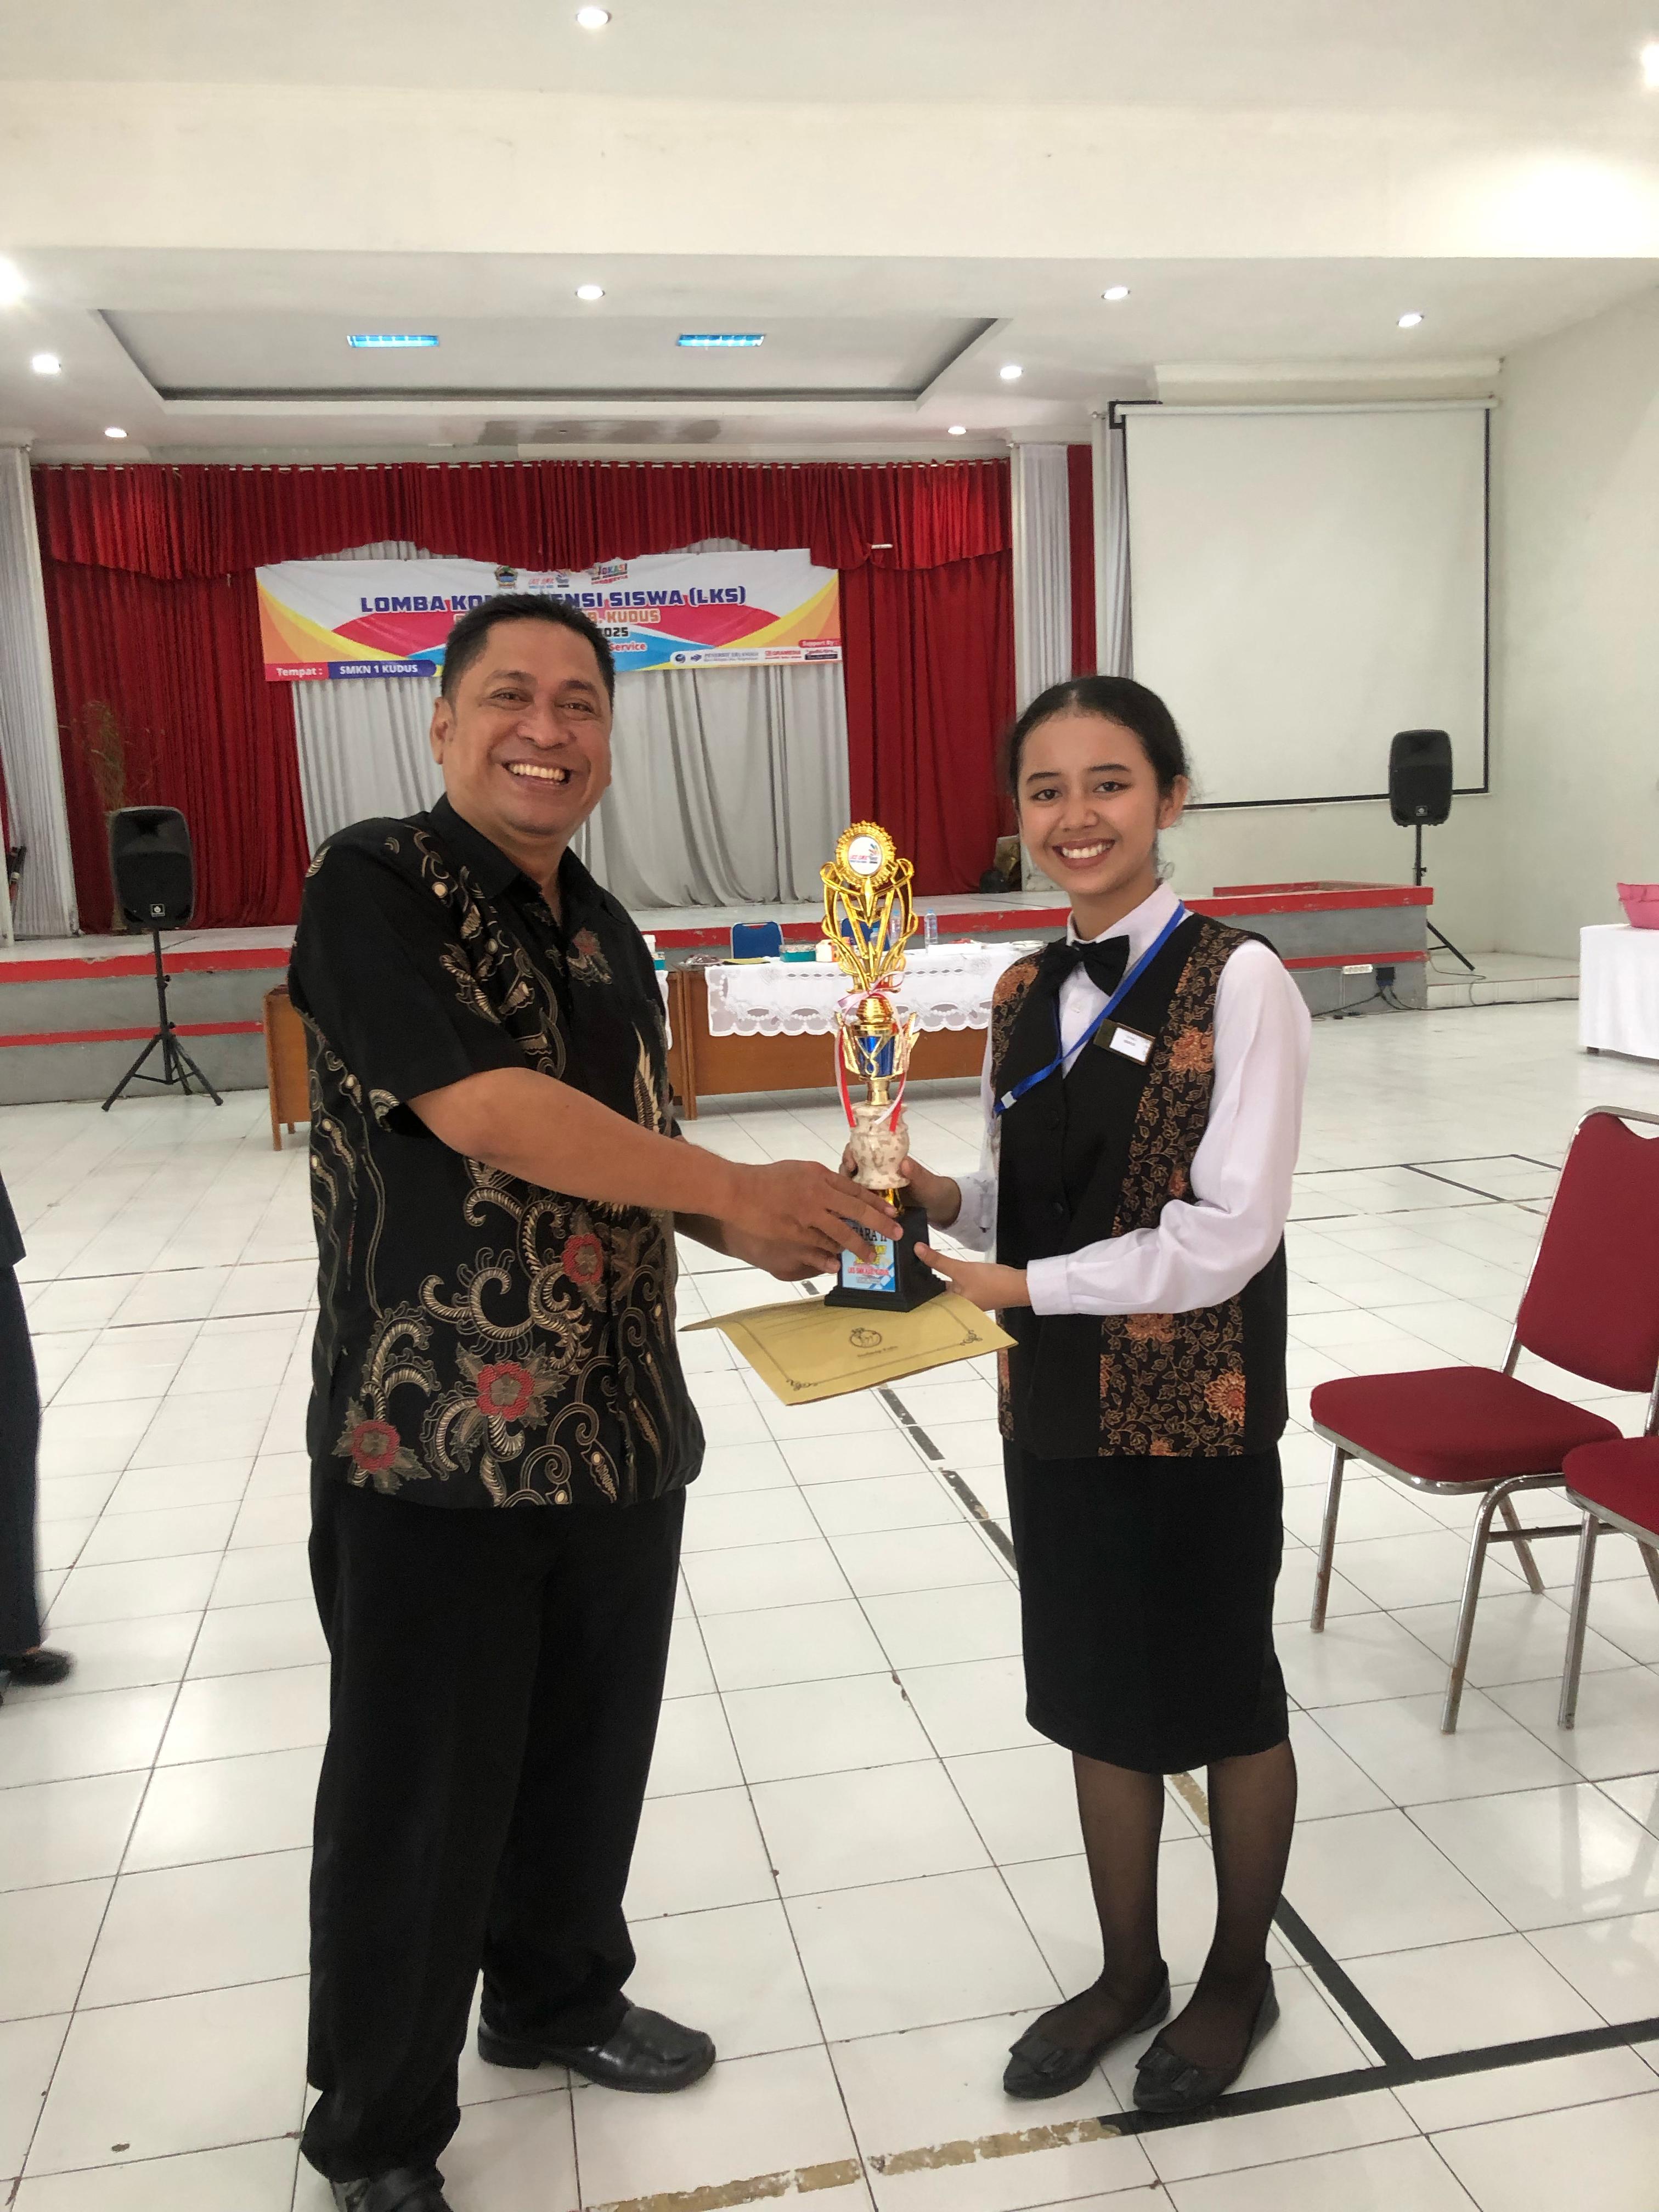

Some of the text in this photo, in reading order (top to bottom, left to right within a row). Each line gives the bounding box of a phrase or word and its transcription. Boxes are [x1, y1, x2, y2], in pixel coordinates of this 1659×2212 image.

[361, 596, 445, 612] LOMBA
[610, 590, 683, 606] SISWA
[689, 586, 746, 606] (LKS)
[607, 610, 658, 623] KUDUS
[599, 627, 629, 637] 025
[609, 641, 646, 651] Service
[276, 667, 317, 676] Tempat
[340, 664, 371, 675] SMKN
[374, 665, 380, 673] 1
[382, 664, 418, 674] KUDUS
